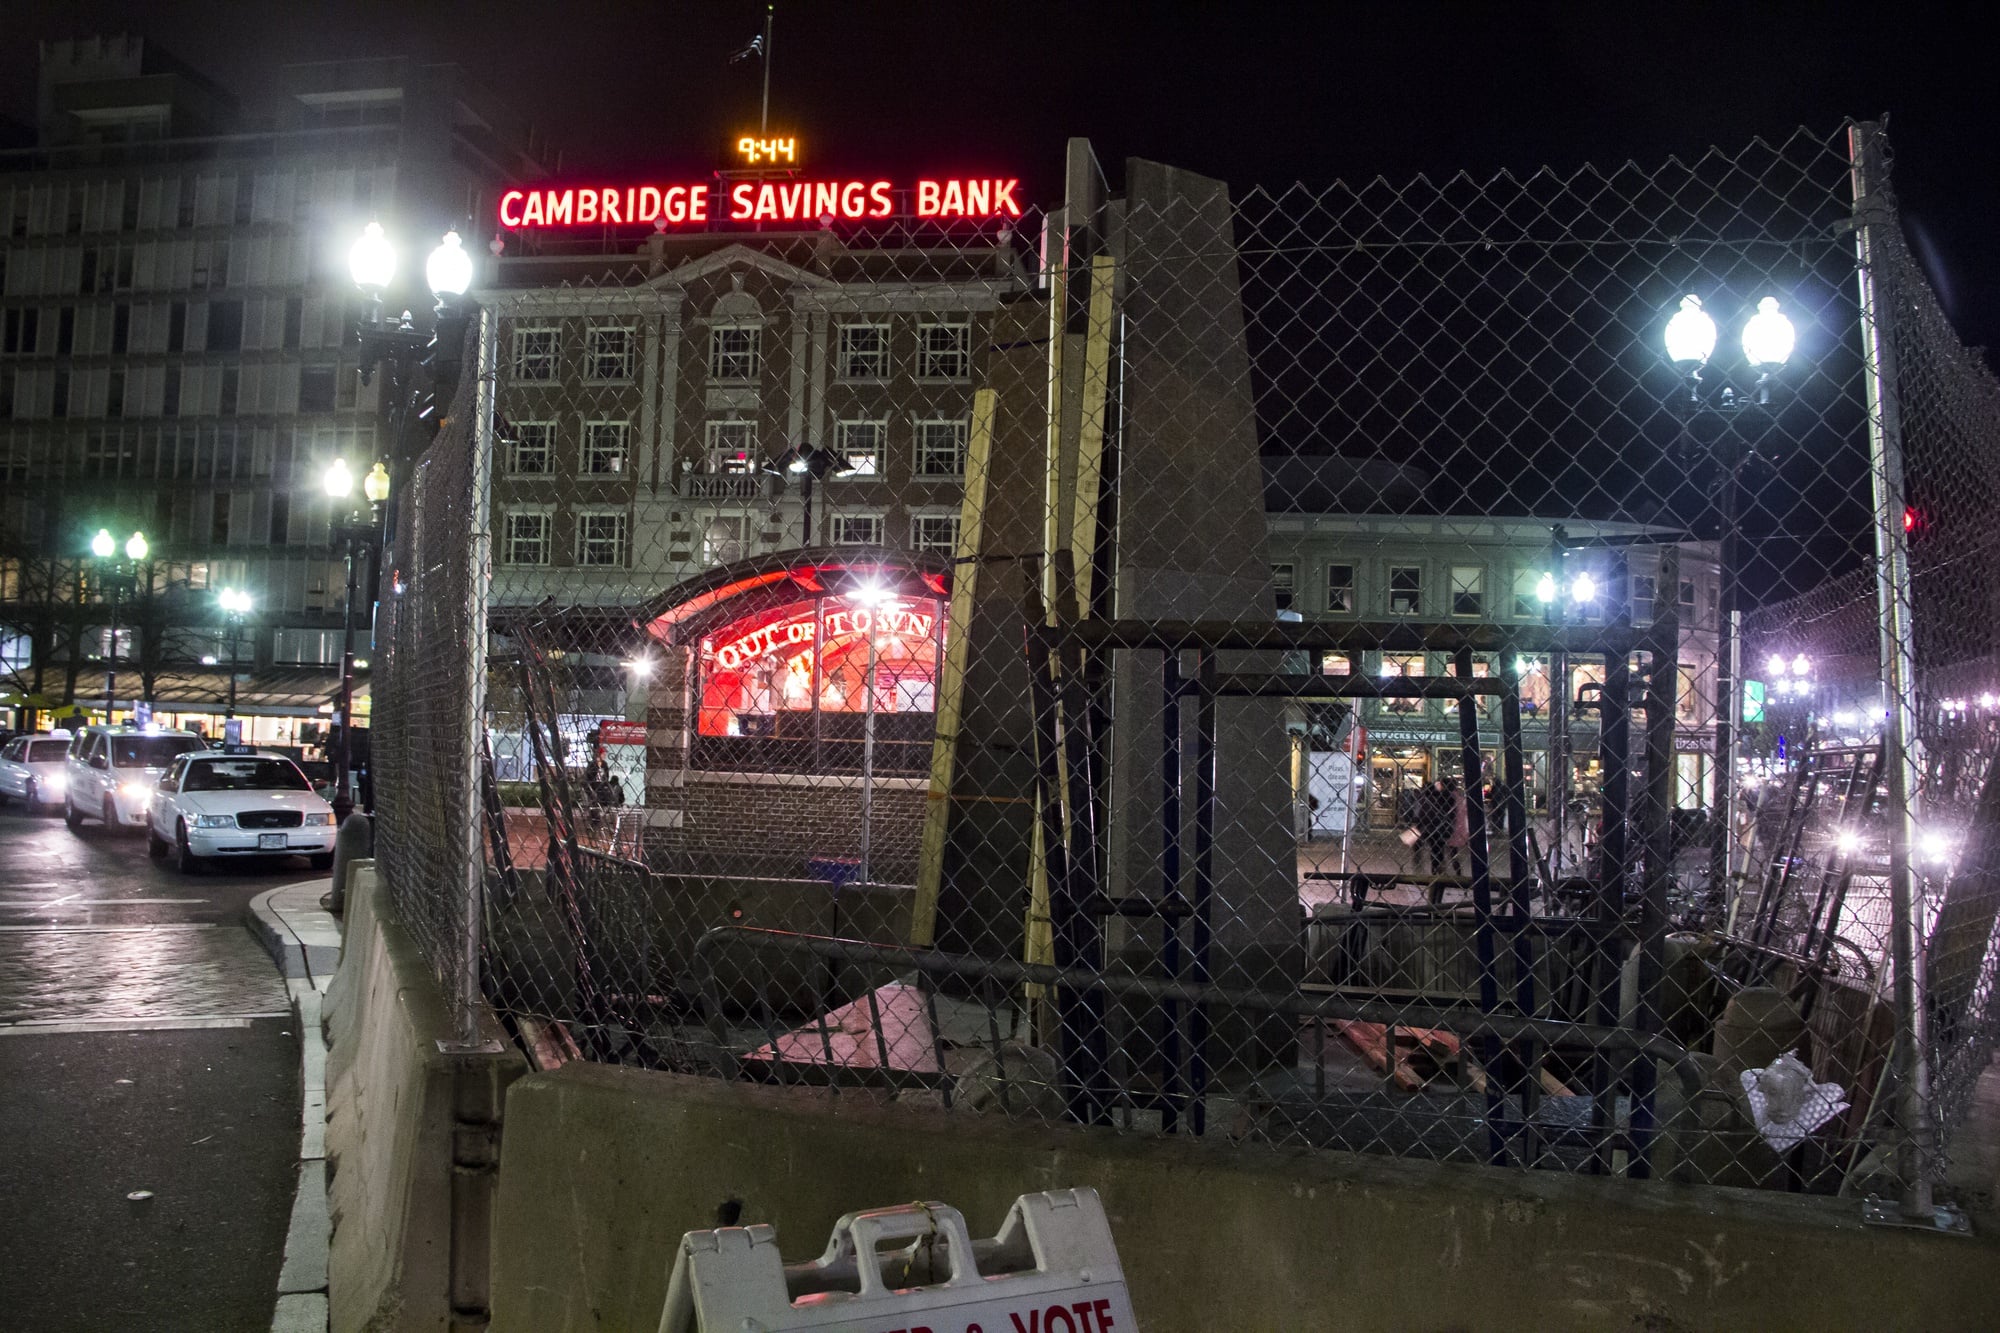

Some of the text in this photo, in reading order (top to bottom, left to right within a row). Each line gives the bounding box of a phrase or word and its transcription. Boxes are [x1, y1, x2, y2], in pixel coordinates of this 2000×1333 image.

[737, 136, 796, 163] 9:44
[498, 177, 1022, 229] CAMBRIDGE SAVINGS BANK
[717, 622, 780, 670] OUT
[825, 608, 932, 638] TOWN
[1009, 1299, 1115, 1333] VOTE
